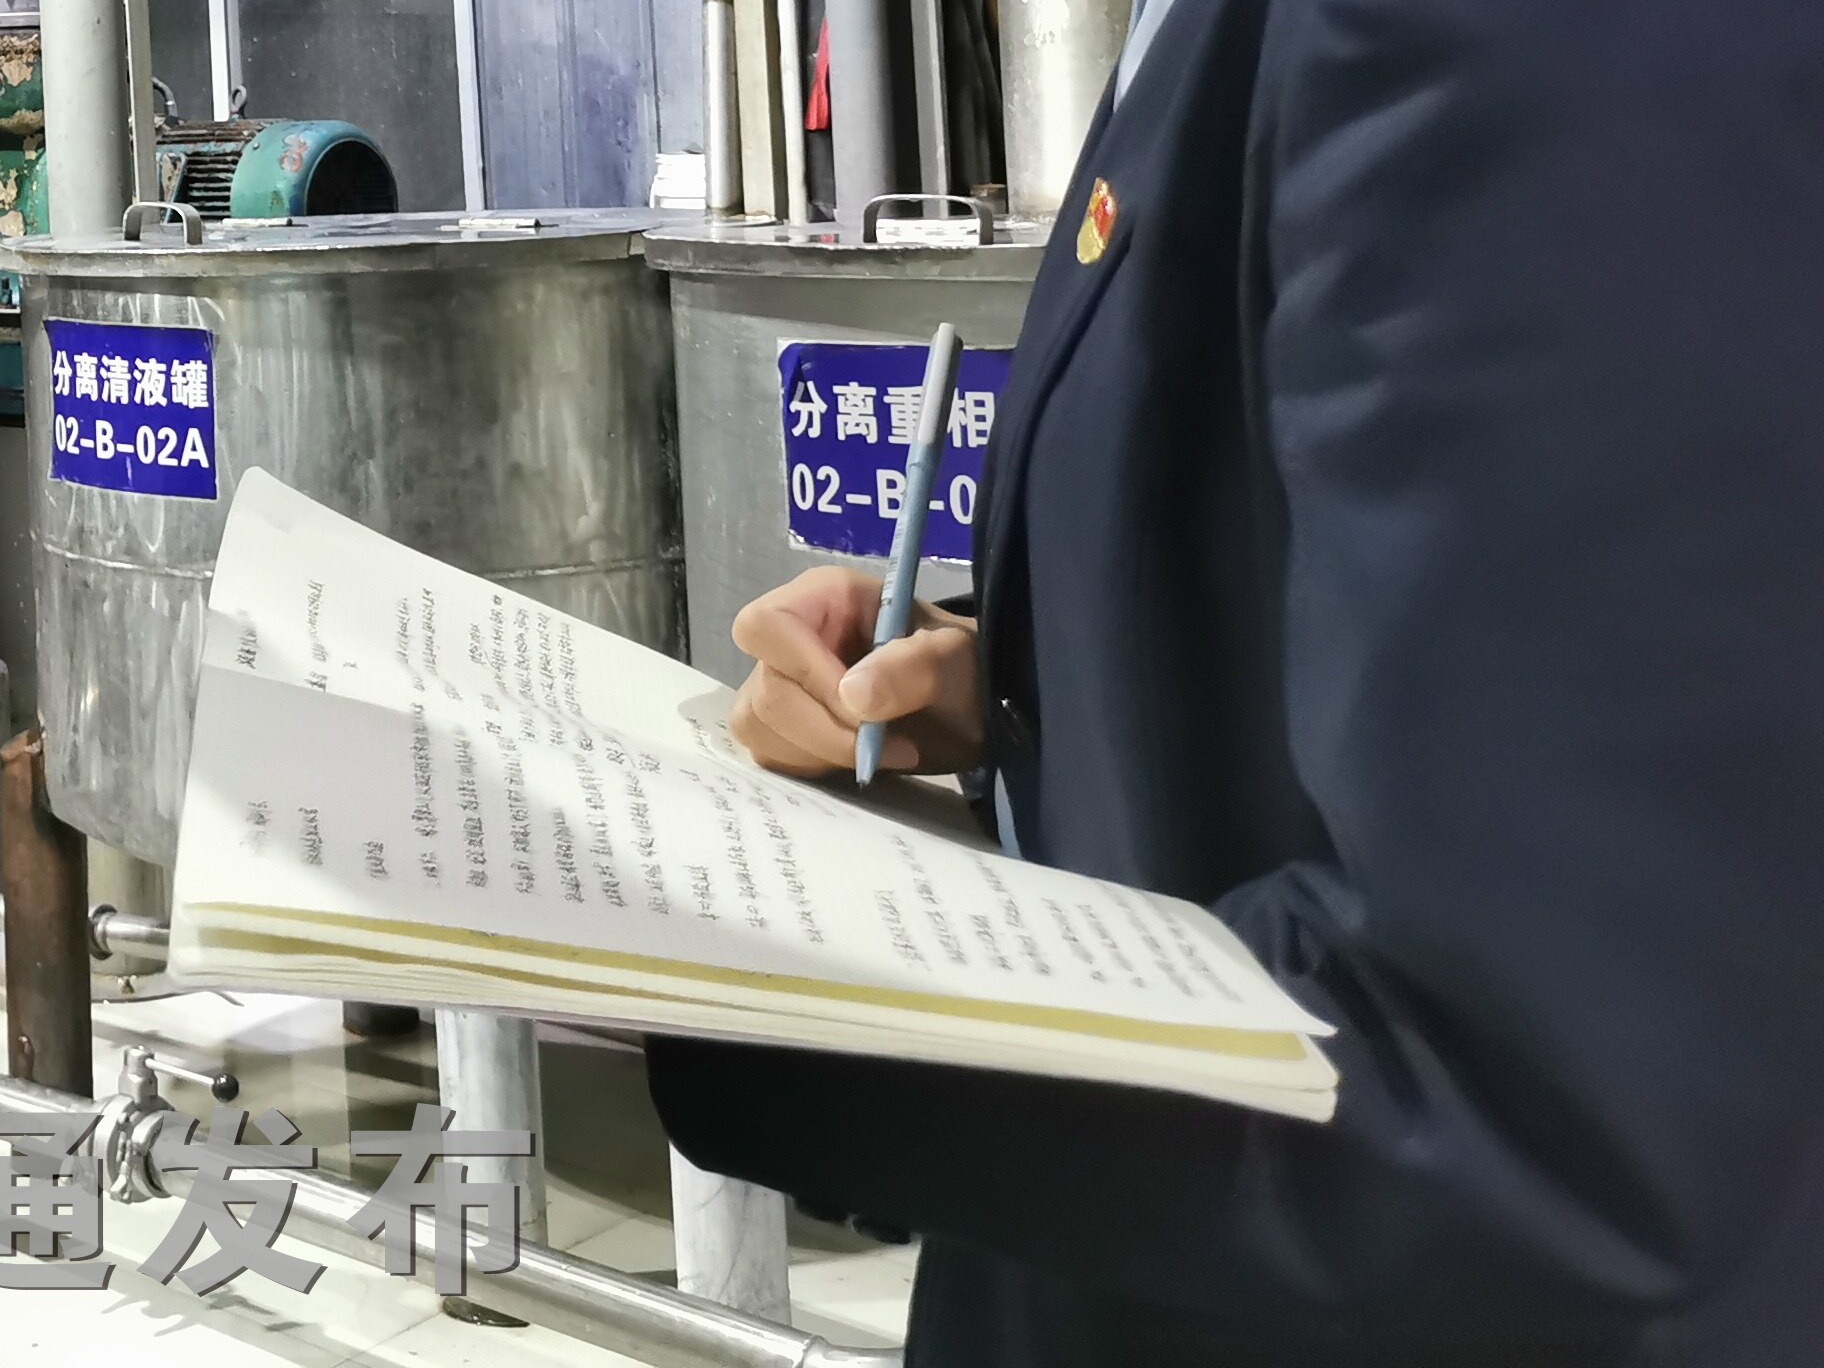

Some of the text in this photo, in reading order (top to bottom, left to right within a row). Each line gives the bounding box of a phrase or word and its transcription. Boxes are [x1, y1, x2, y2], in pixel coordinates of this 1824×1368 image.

[53, 350, 210, 409] 分离清液罐
[55, 413, 210, 469] 02-B-02A
